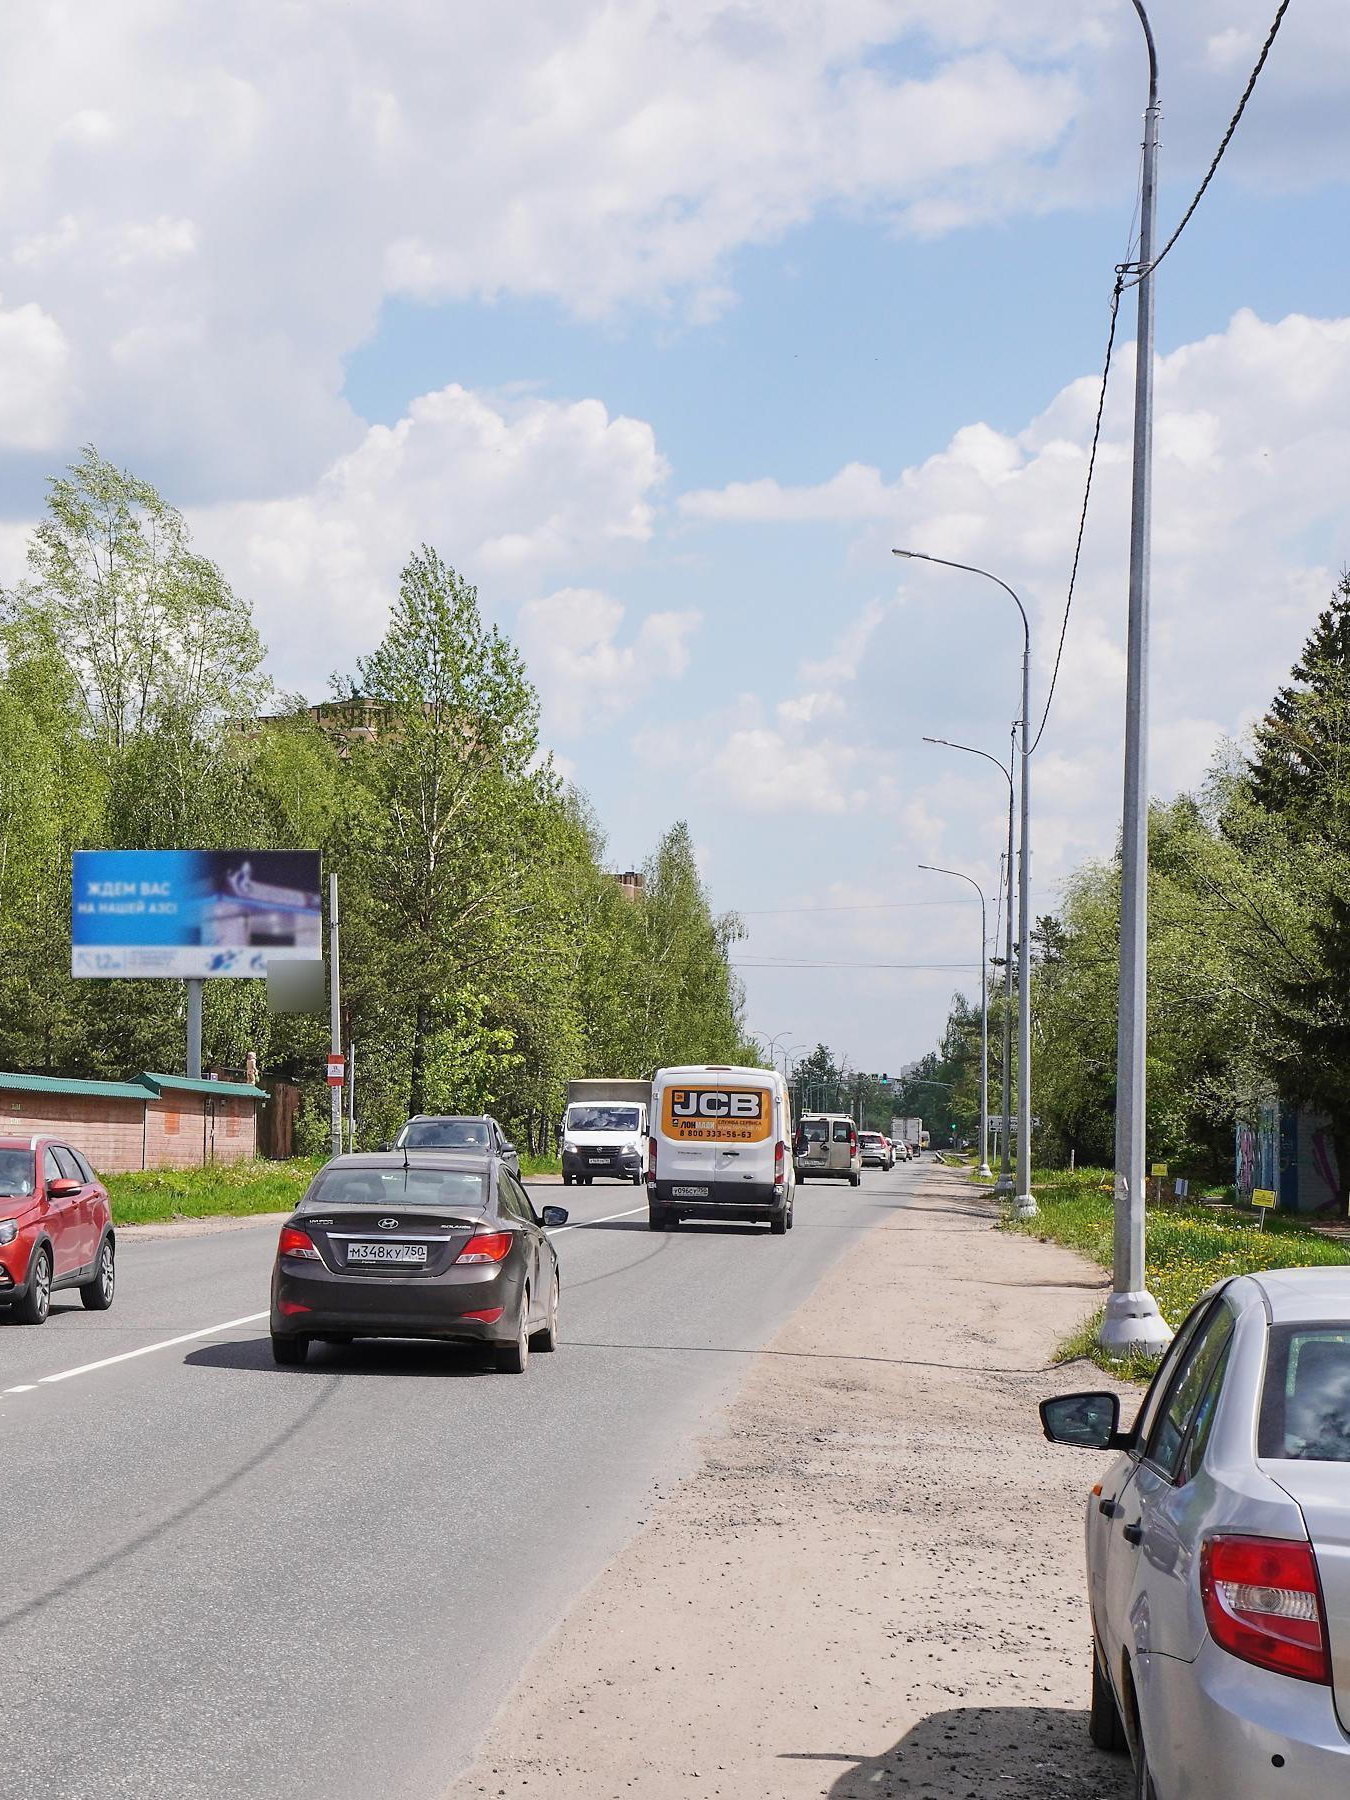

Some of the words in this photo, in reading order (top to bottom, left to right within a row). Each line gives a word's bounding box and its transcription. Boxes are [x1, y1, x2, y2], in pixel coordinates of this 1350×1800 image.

[141, 882, 170, 896] ВАС
[78, 902, 95, 914] НА
[98, 900, 145, 914] НАШЕЙ
[673, 1092, 760, 1117] JCB
[351, 1245, 401, 1260] М348КУ
